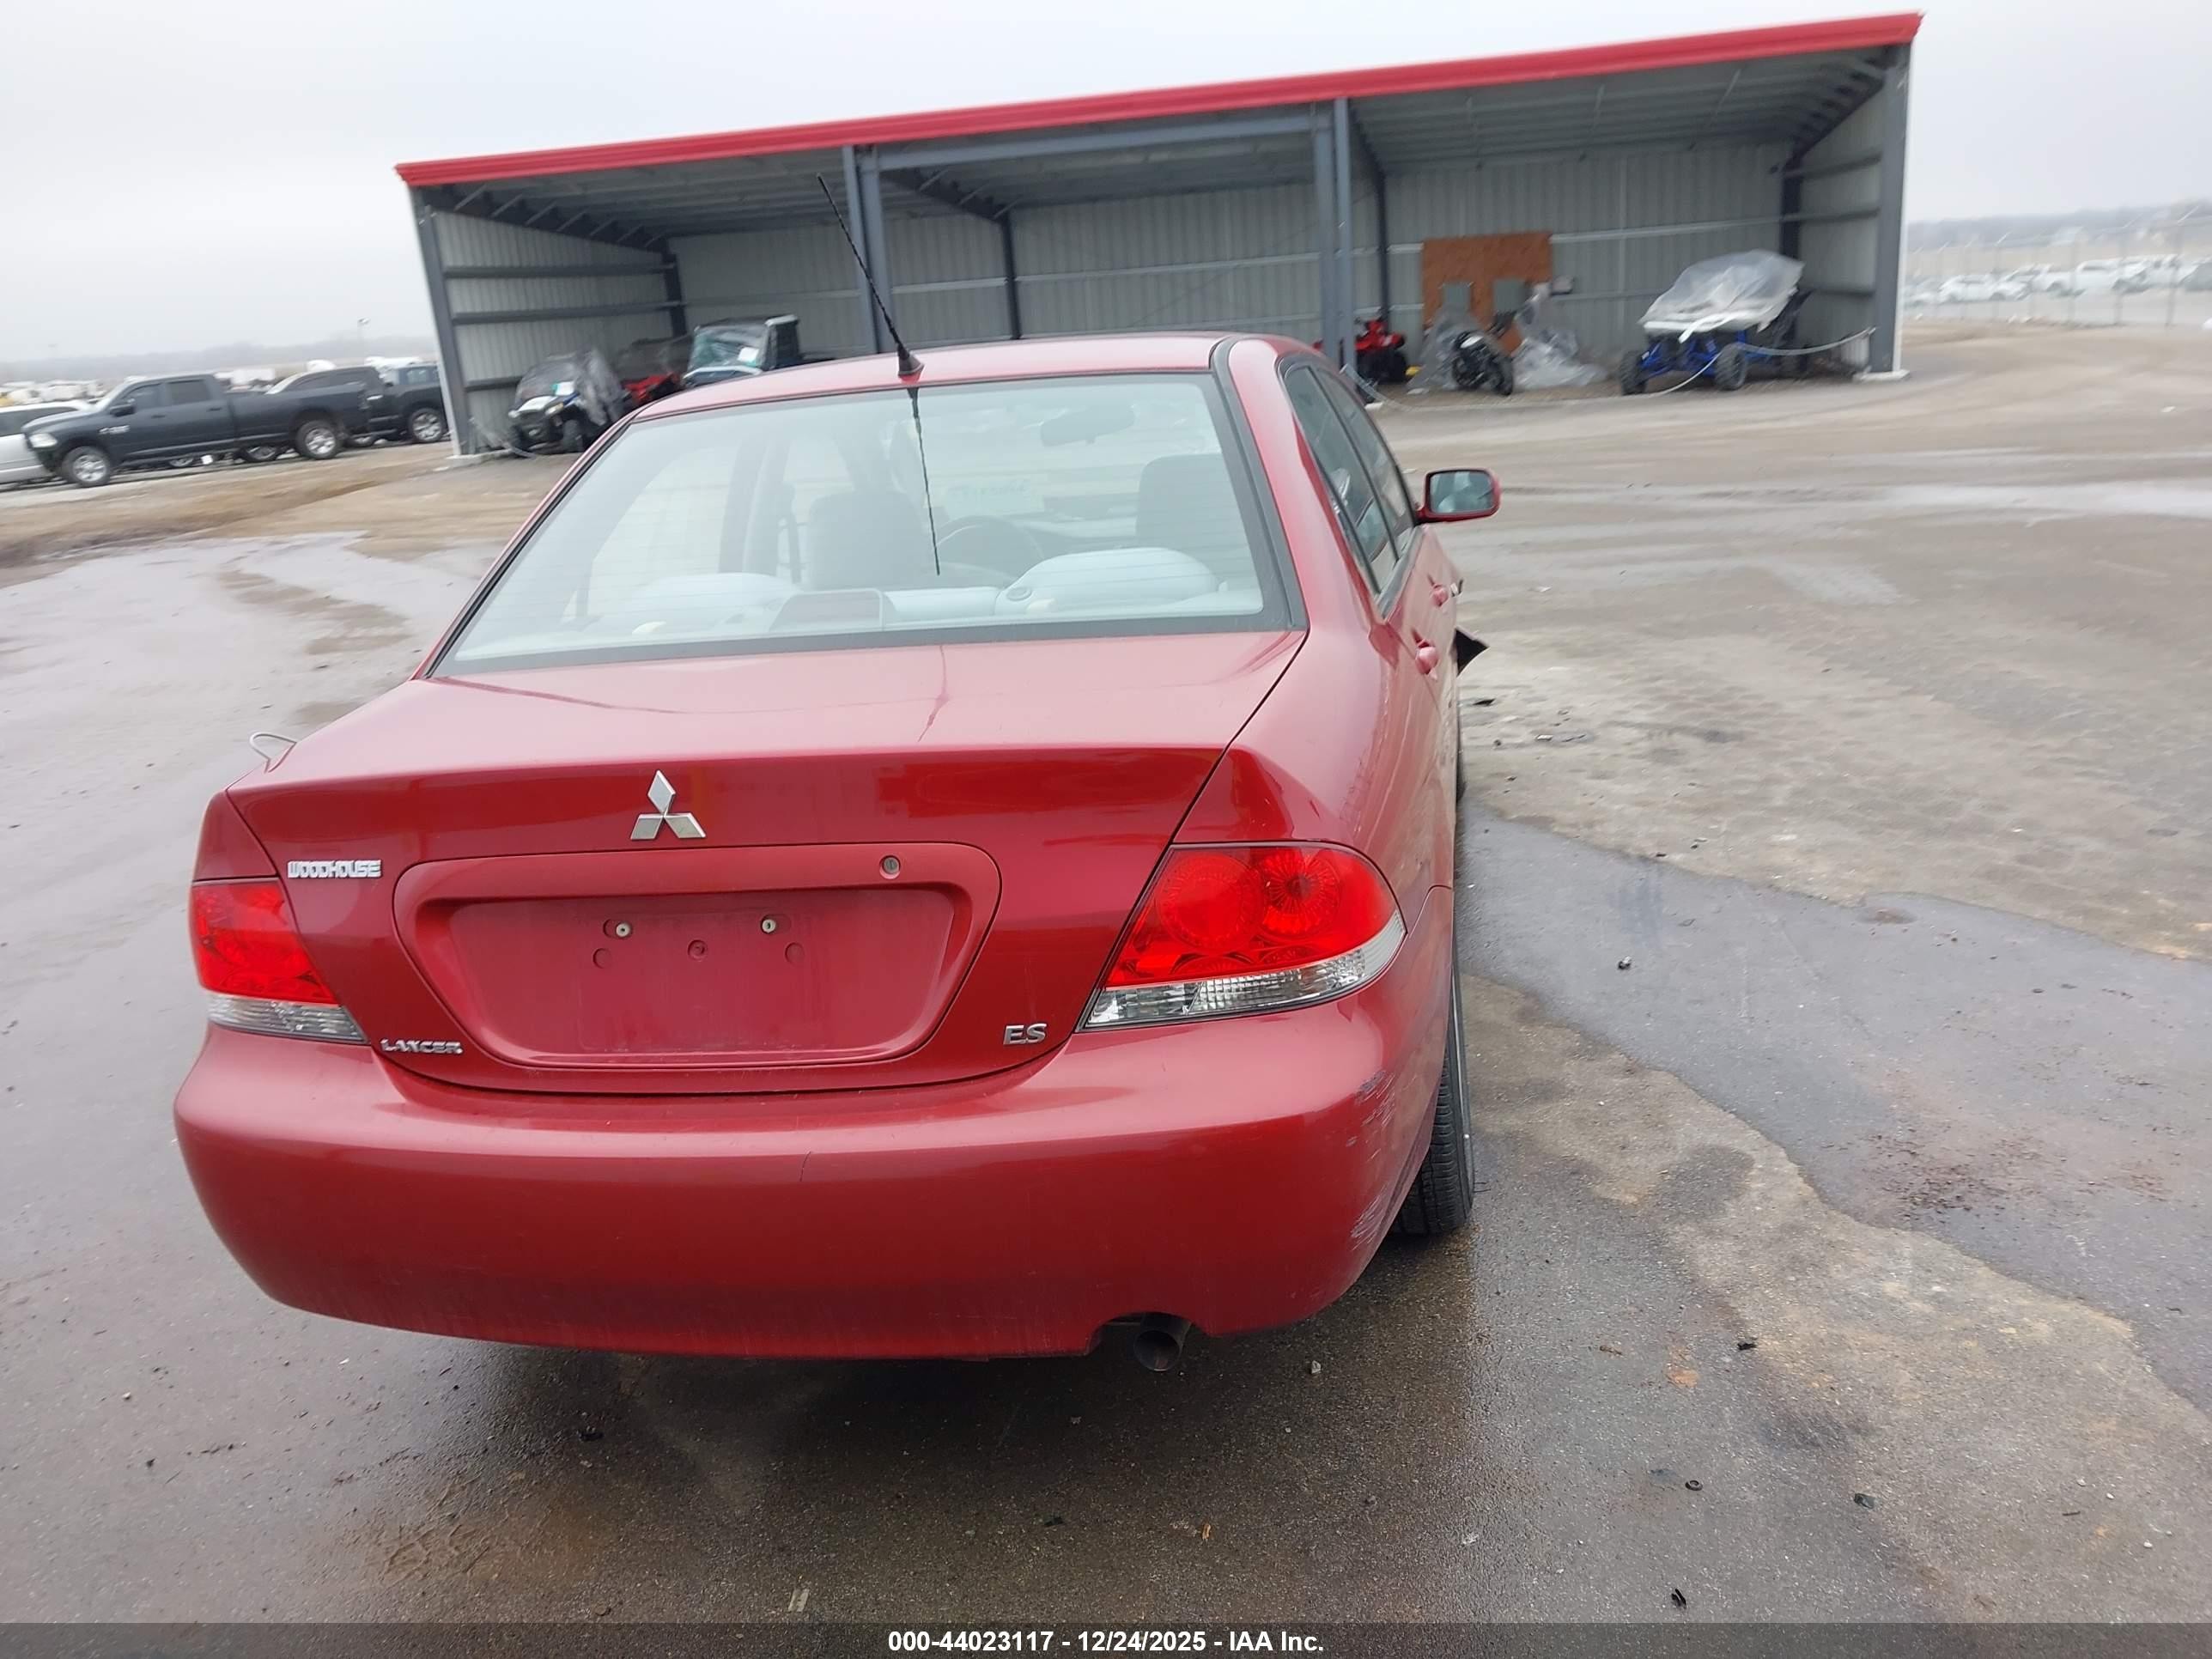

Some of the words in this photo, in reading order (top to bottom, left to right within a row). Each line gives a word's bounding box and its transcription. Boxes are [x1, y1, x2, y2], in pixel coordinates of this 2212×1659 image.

[287, 860, 381, 878] WOODHOUSE
[1003, 1023, 1047, 1045] ES
[380, 1038, 463, 1054] LANCER
